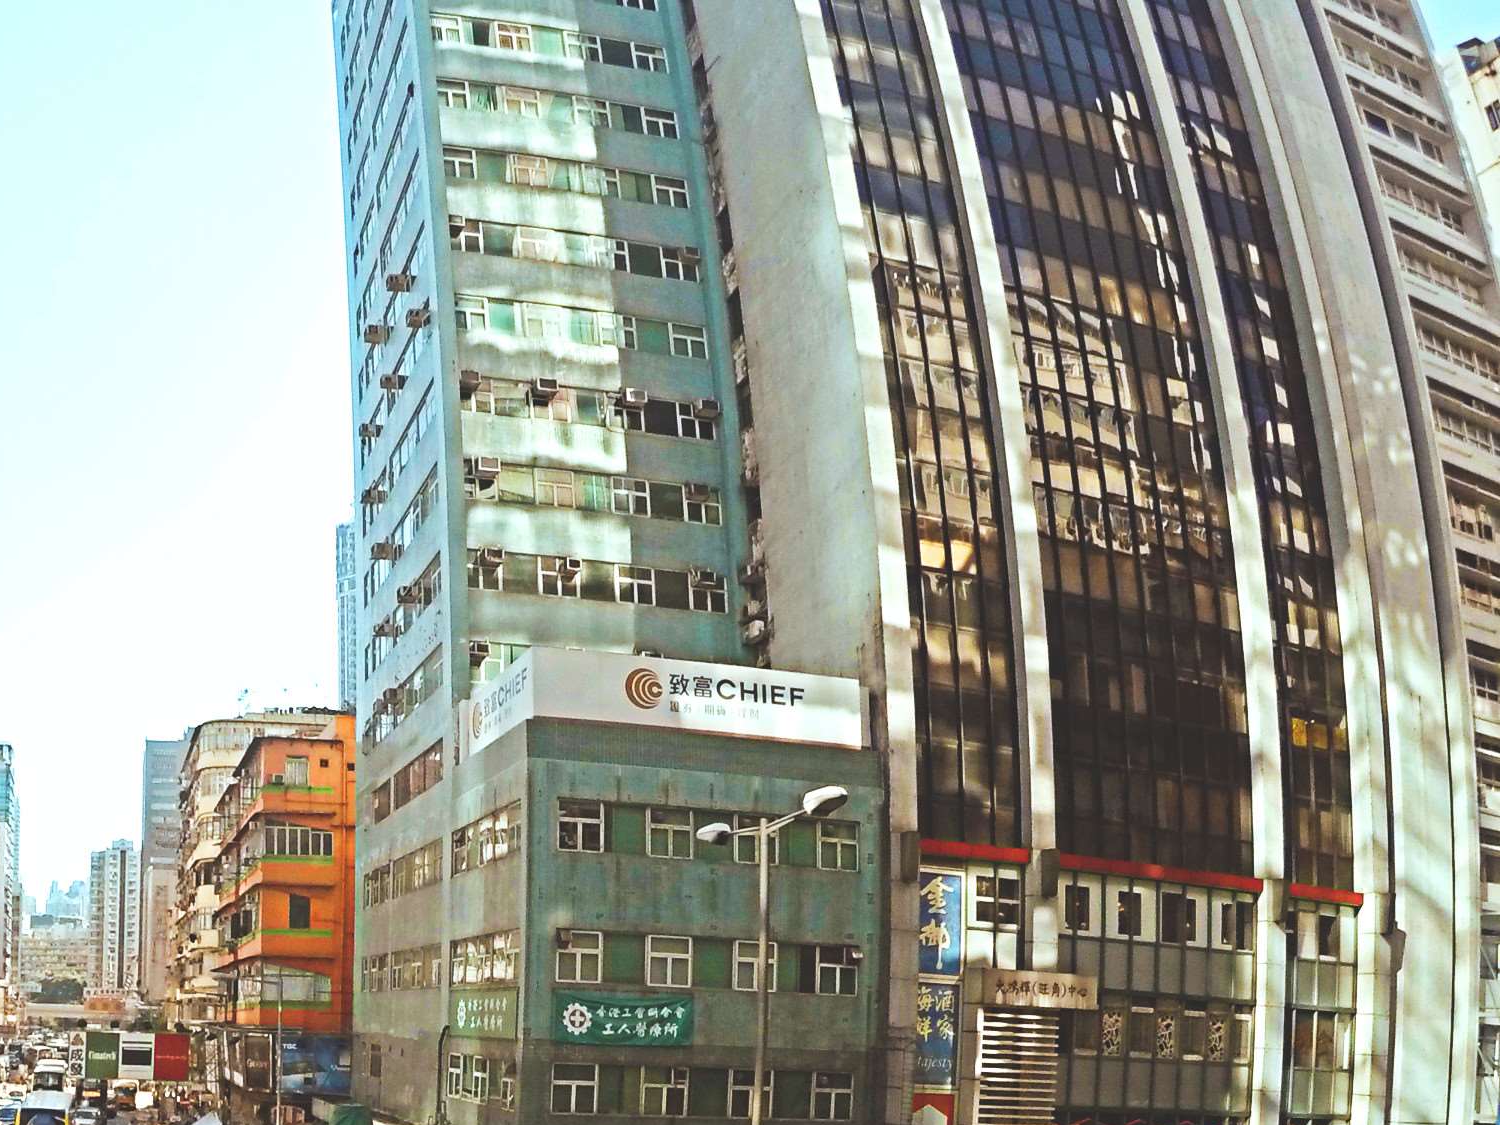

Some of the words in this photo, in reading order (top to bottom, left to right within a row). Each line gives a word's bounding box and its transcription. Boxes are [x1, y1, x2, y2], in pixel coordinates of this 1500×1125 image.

[498, 667, 527, 706] CHIEF
[669, 674, 712, 697] 致富
[716, 679, 804, 706] CHIEF
[917, 1055, 952, 1074] ajesty
